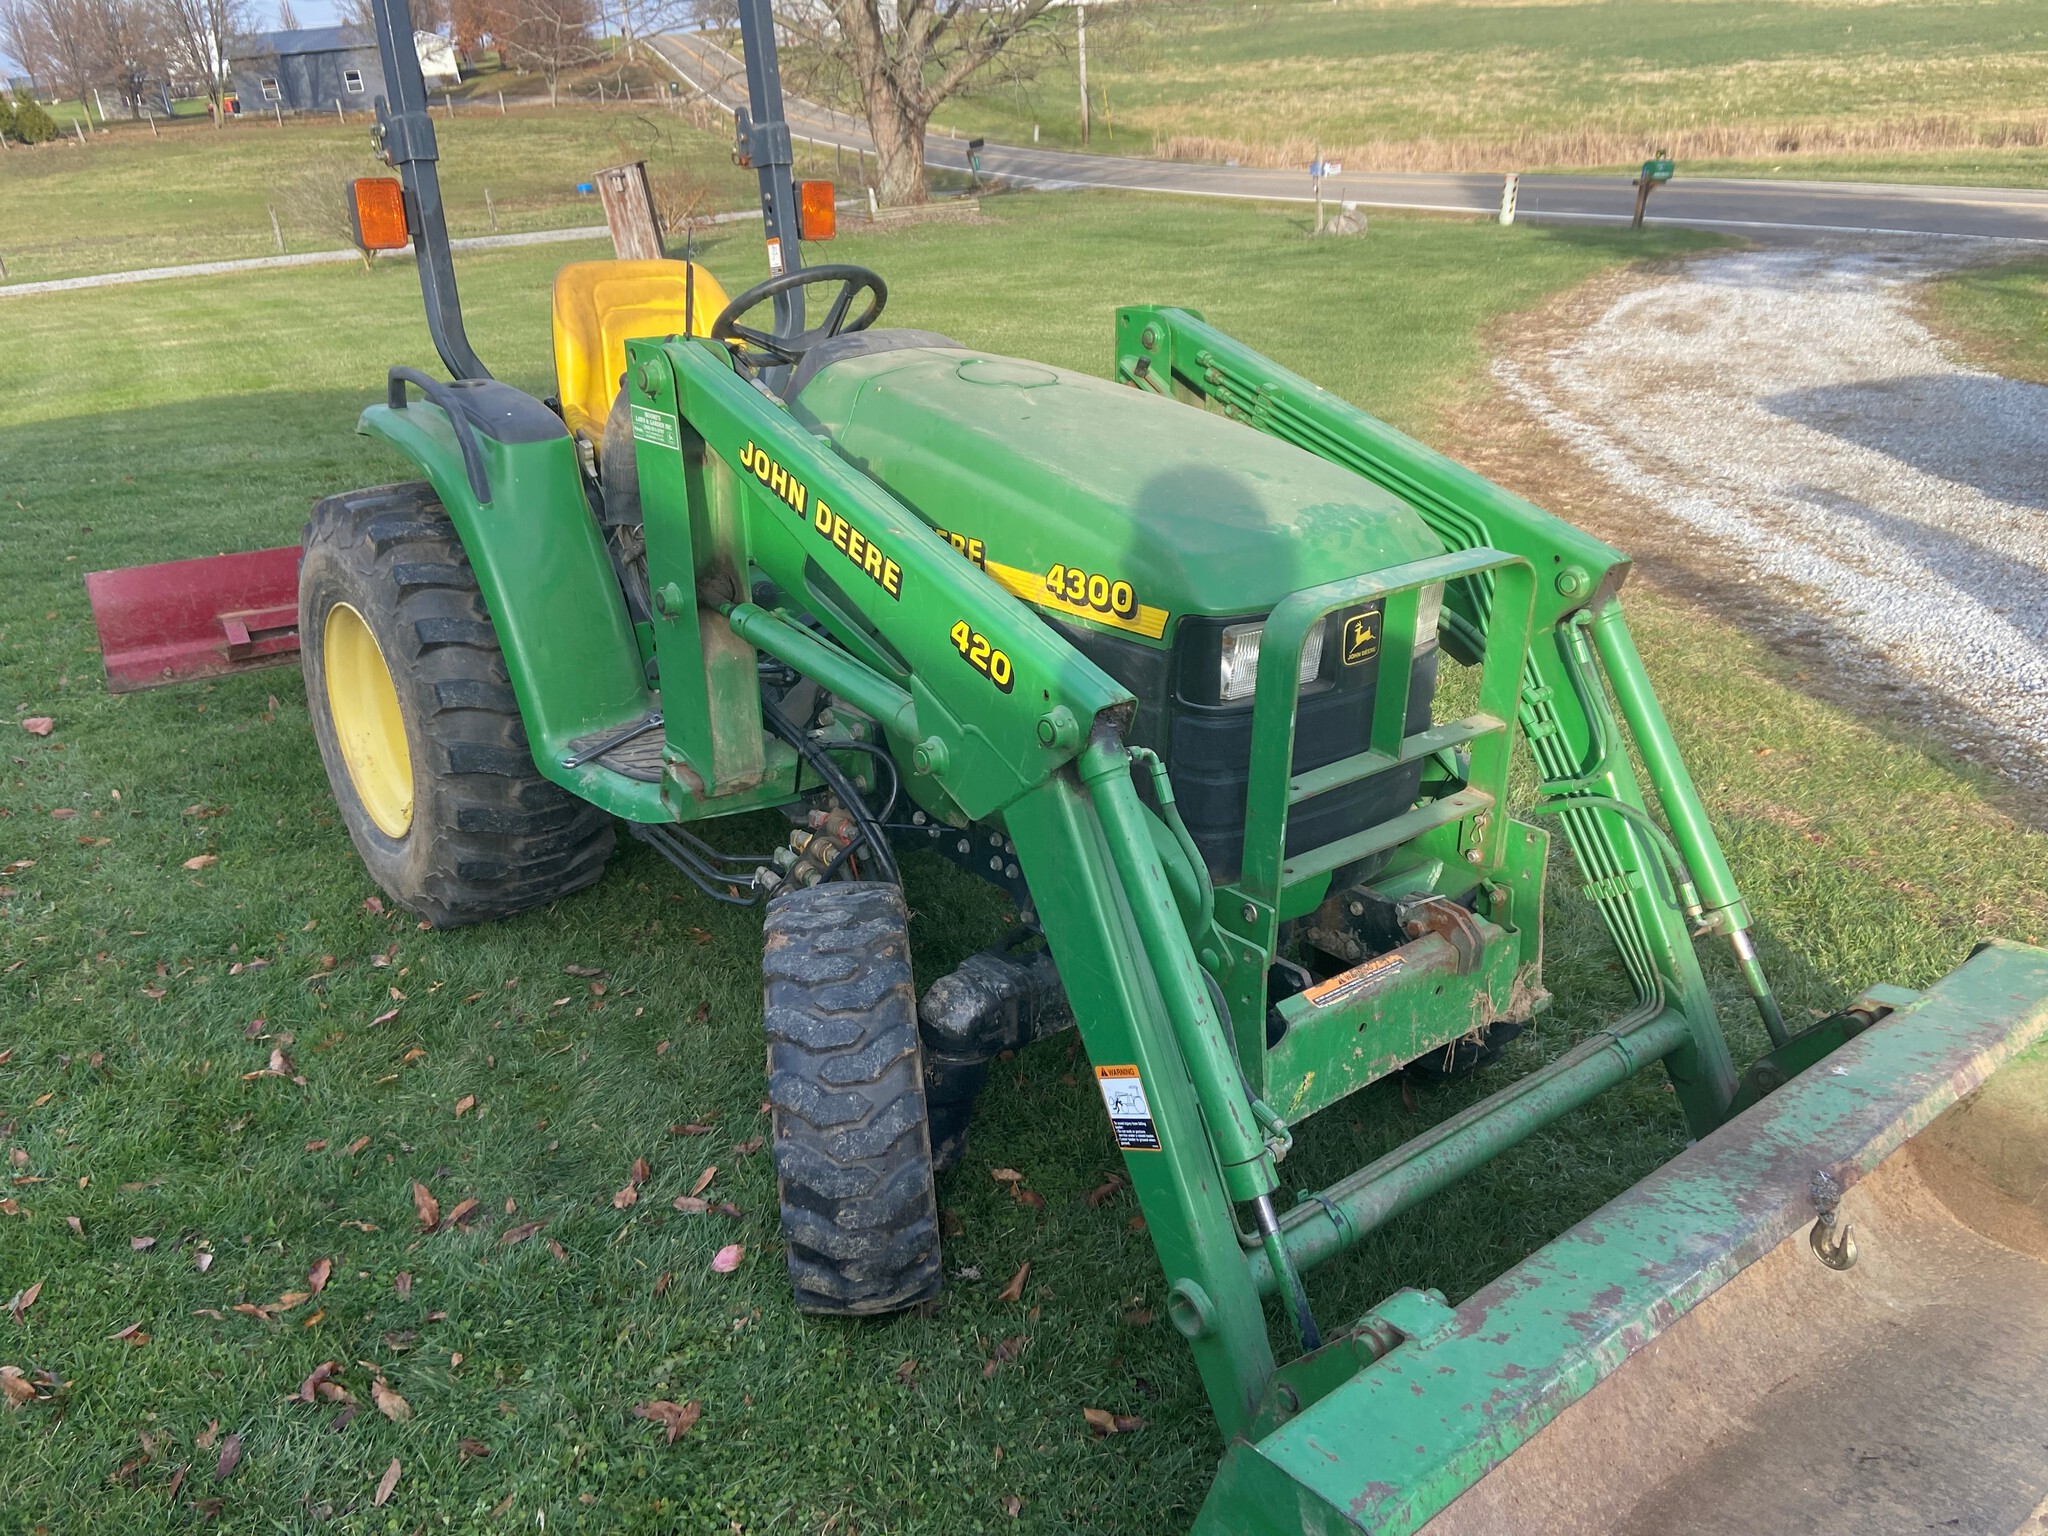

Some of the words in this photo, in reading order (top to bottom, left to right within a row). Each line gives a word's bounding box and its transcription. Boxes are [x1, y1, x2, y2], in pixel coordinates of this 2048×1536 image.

[740, 439, 808, 520] JOHN
[814, 498, 904, 602] DEERE
[1046, 563, 1139, 620] 4300
[950, 619, 1014, 694] 420
[1348, 651, 1361, 661] JOHN
[1362, 646, 1376, 656] DEERE
[1108, 1067, 1135, 1077] WARNING
